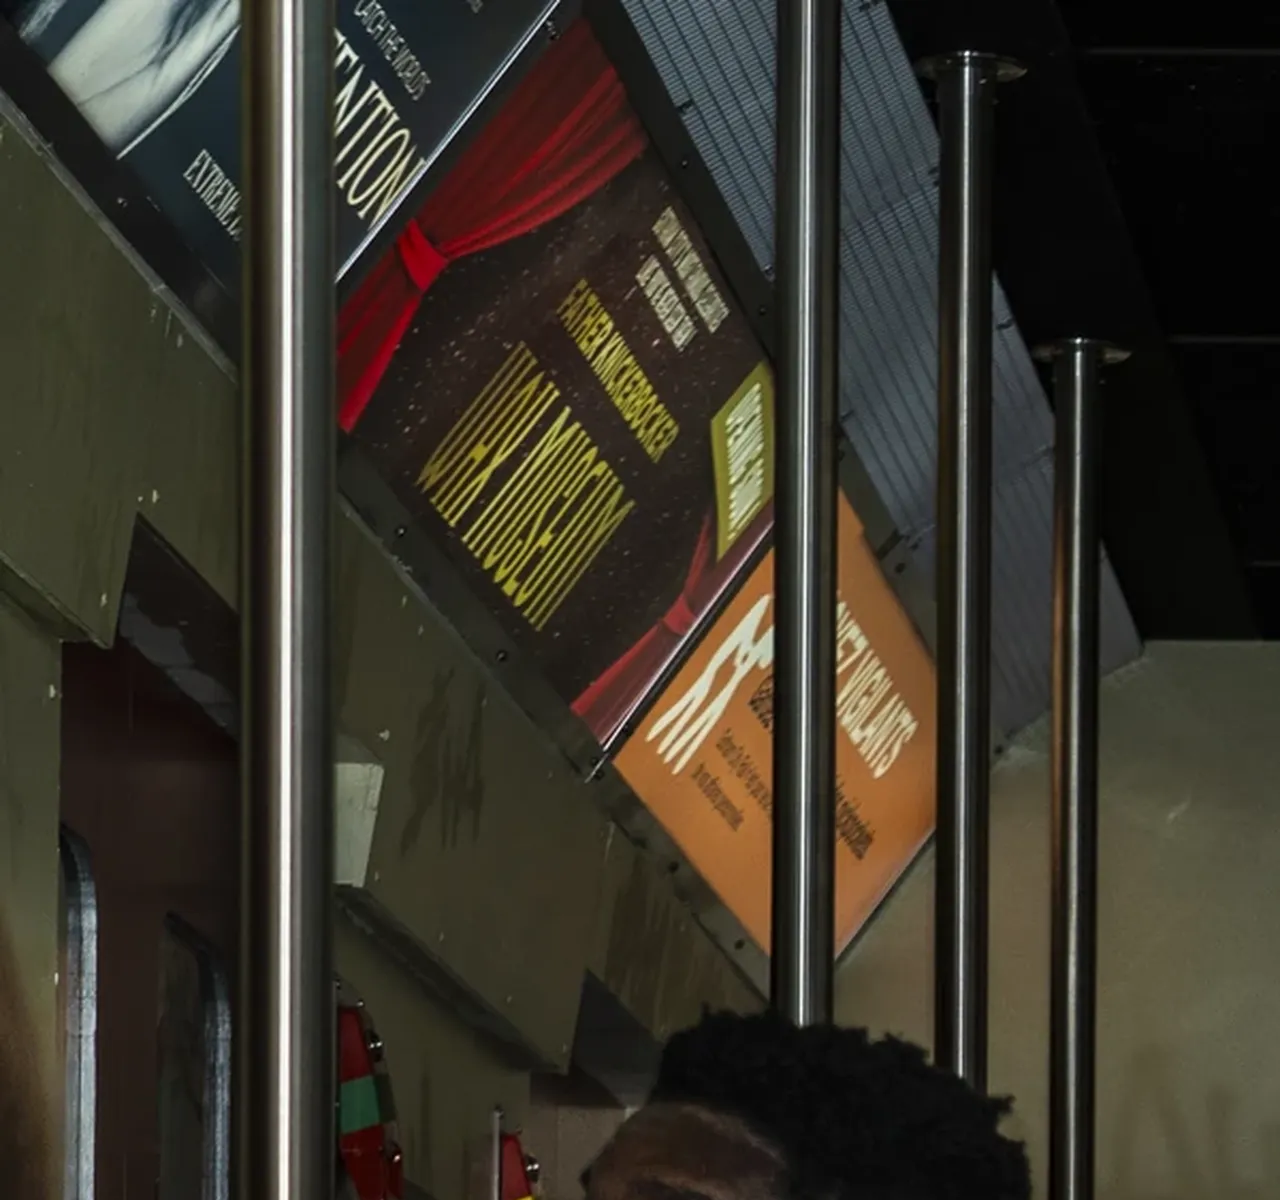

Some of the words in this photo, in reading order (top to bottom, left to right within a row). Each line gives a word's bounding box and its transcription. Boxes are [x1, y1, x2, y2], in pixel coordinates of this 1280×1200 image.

[334, 28, 427, 231] NTION
[413, 340, 561, 528] WAX
[556, 278, 615, 362] FATHER
[590, 331, 680, 464] KNICKERBOCKER
[461, 404, 637, 632] MUSEUM
[836, 649, 919, 780] VIGILANTS
